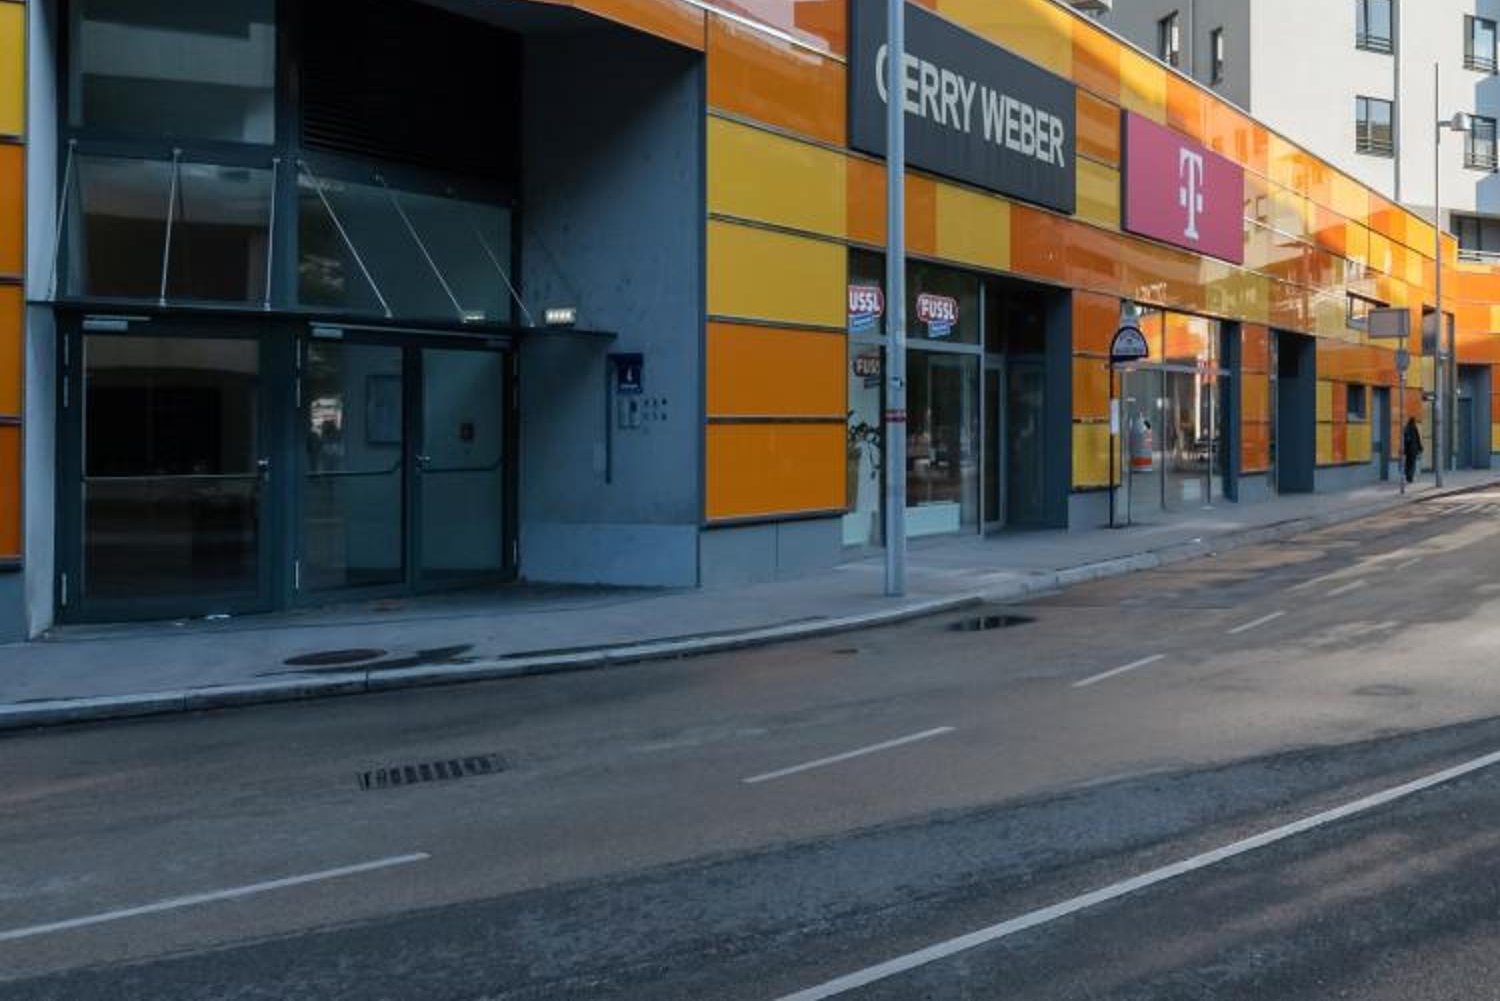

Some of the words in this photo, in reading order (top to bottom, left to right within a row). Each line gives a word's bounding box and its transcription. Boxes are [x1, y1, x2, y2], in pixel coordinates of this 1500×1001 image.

[980, 85, 1066, 168] WEBER
[1179, 147, 1204, 240] T
[848, 289, 881, 312] USSL
[921, 298, 955, 319] FUSSL
